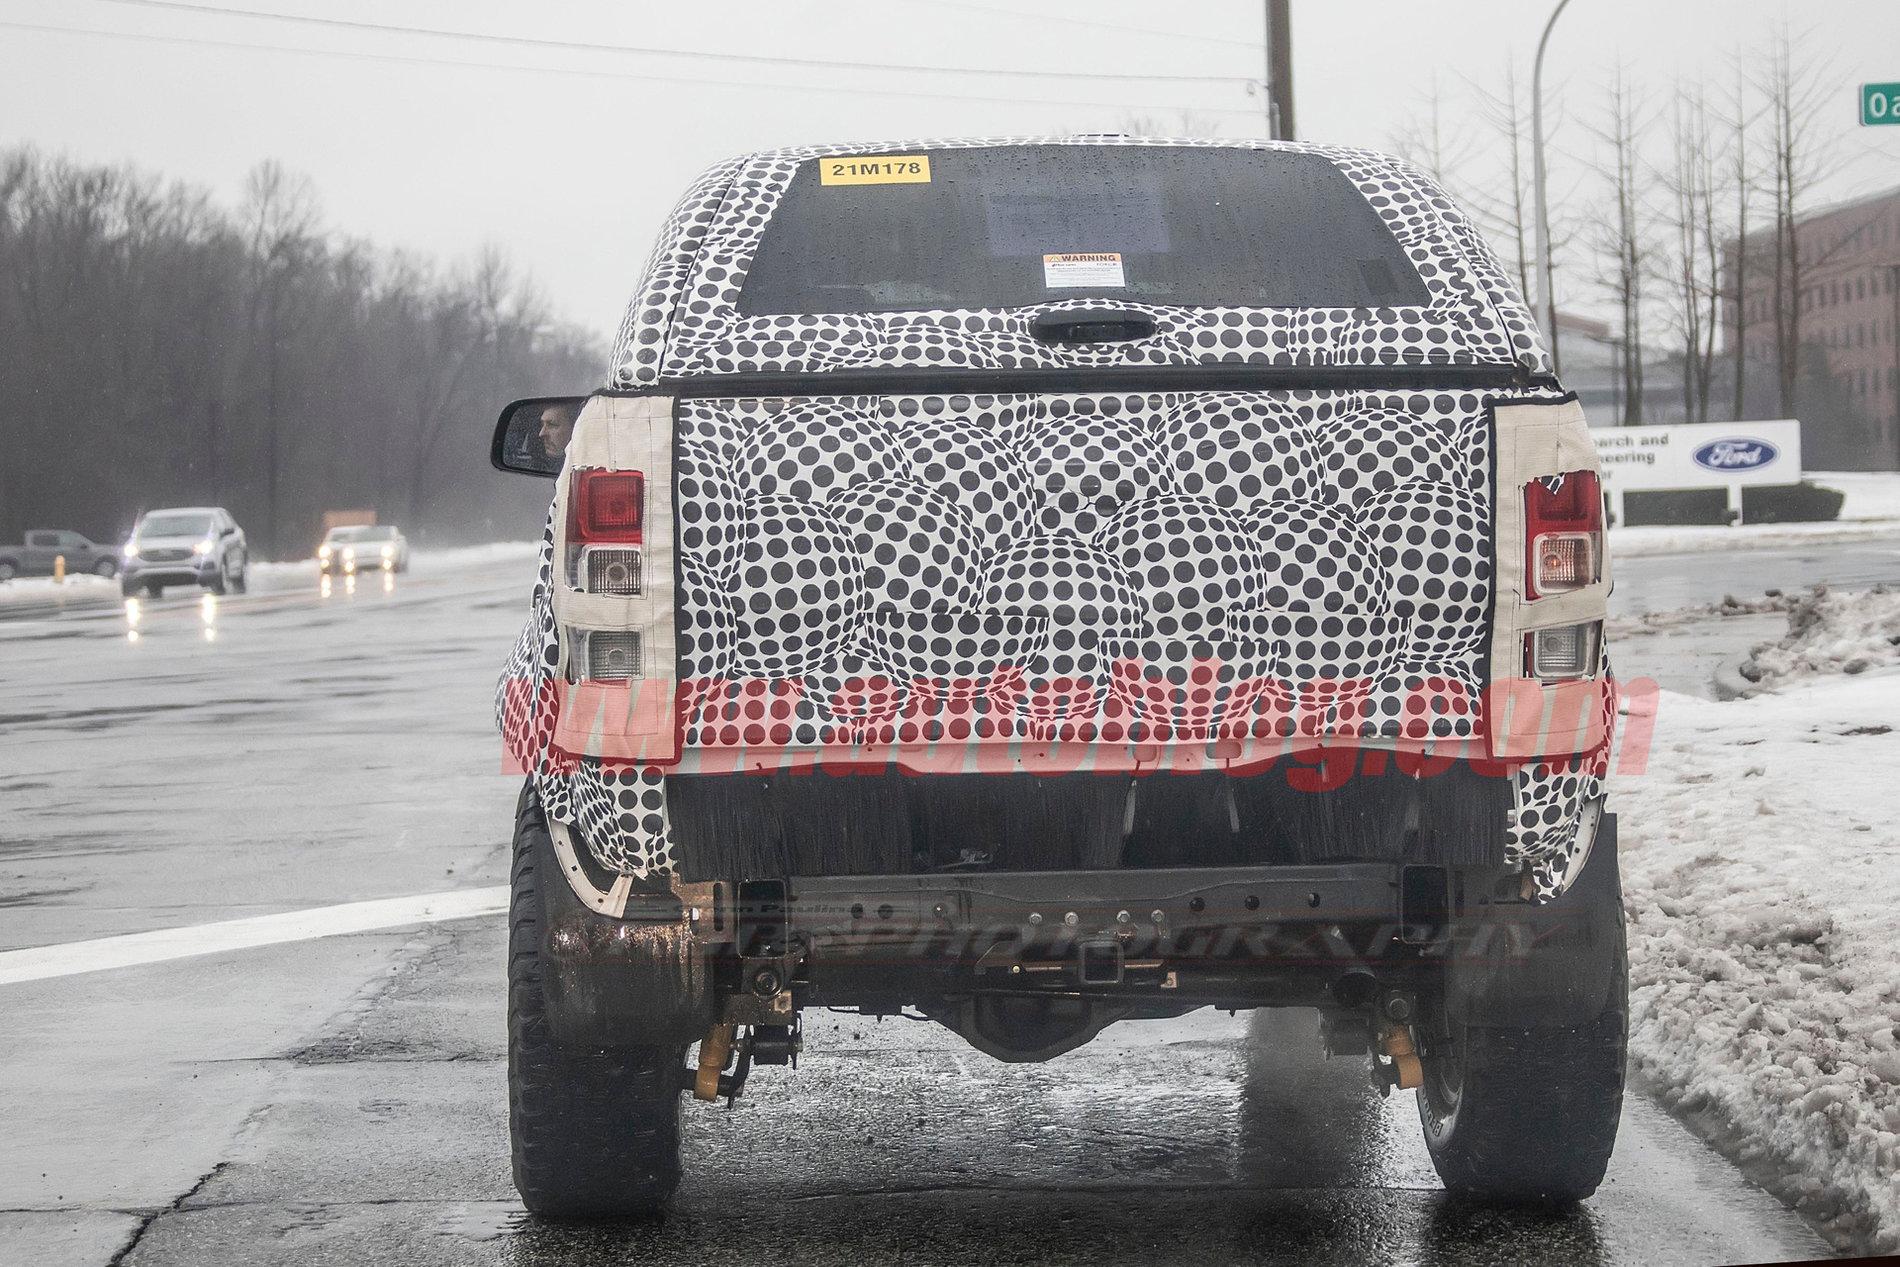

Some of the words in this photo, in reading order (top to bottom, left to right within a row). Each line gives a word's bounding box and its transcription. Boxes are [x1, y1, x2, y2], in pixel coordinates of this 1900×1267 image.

[832, 162, 921, 176] 21M178
[1061, 254, 1116, 262] WARNING
[1640, 433, 1669, 446] and
[1708, 442, 1762, 466] Ford
